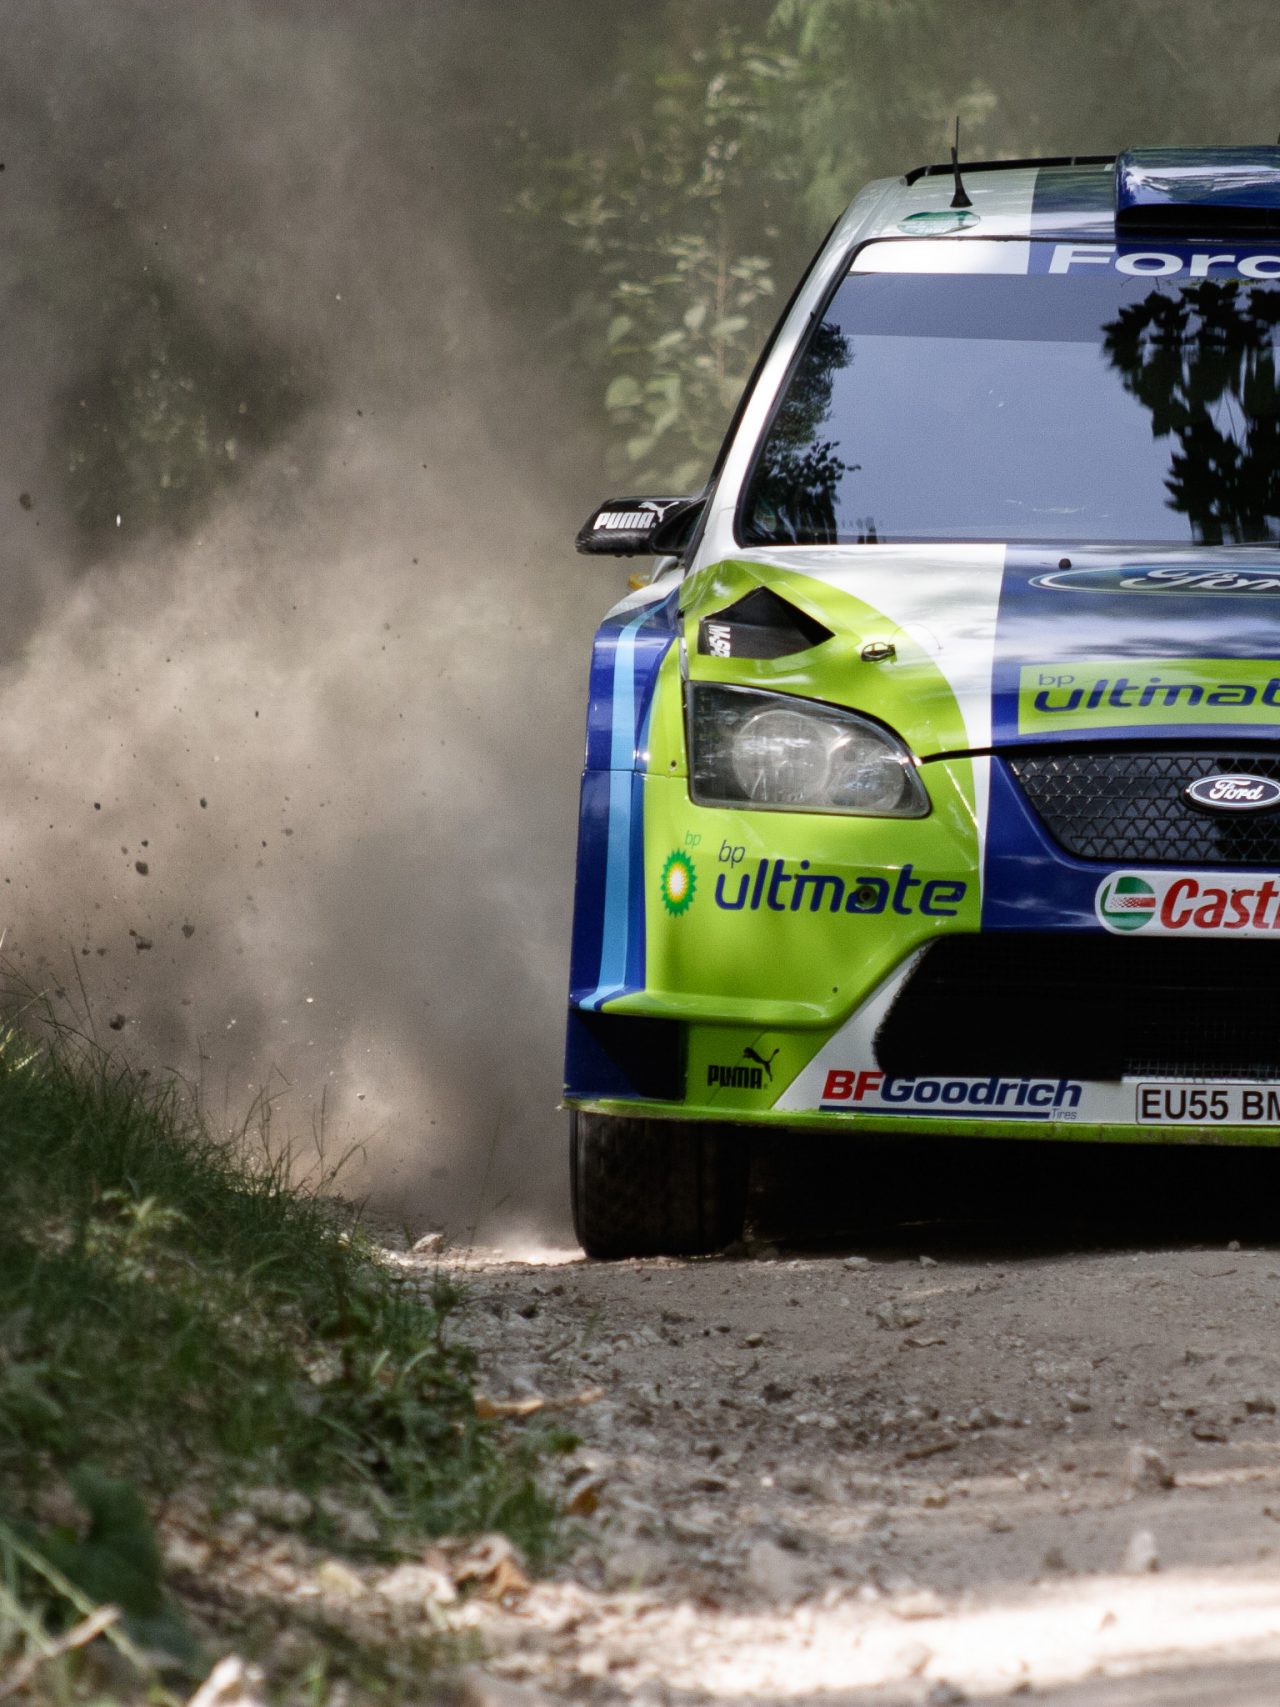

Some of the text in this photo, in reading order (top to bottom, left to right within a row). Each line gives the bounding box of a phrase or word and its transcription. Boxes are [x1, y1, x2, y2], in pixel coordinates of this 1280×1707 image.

[593, 512, 656, 530] PUMA
[1039, 673, 1075, 688] bp
[1209, 779, 1264, 801] Ford
[685, 830, 702, 848] bp
[718, 839, 746, 869] bp
[715, 858, 967, 916] ultimate
[708, 1065, 762, 1089] PUMA
[822, 1069, 1083, 1108] BFGoodrich
[1051, 1108, 1078, 1121] Tires
[1142, 1089, 1229, 1121] EU55
